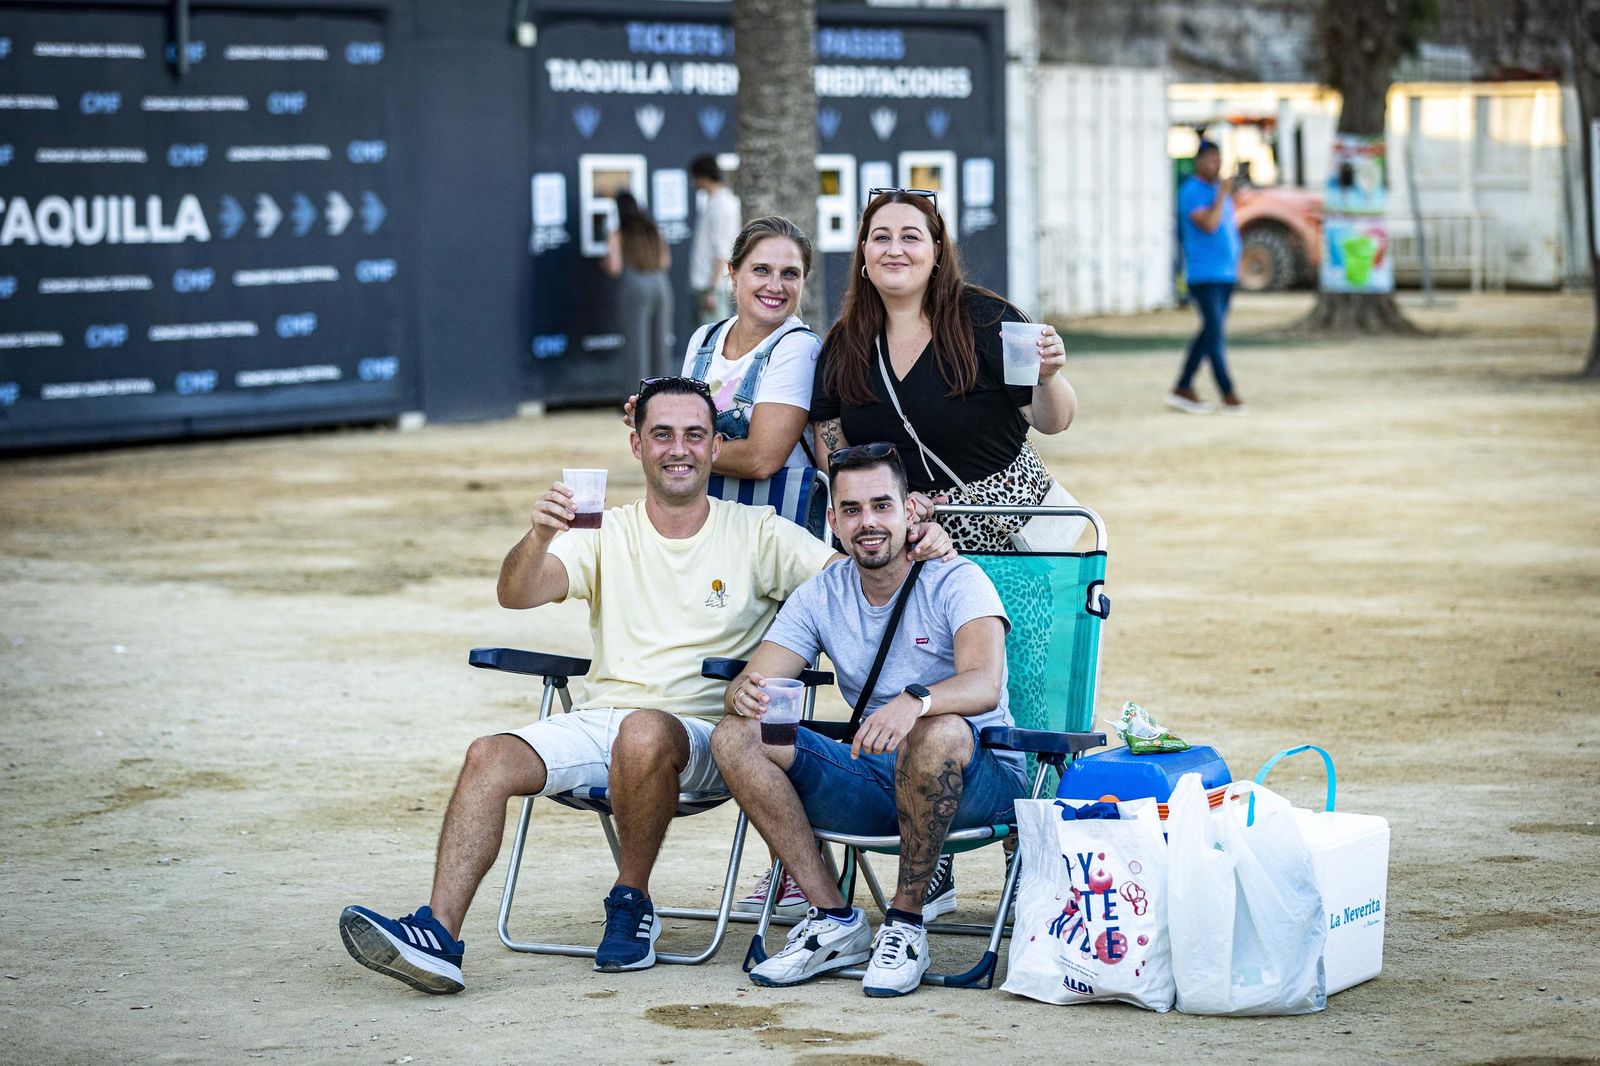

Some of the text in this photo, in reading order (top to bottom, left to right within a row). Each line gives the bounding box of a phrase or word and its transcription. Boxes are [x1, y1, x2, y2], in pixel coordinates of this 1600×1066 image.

[625, 23, 723, 56] TICKETS
[545, 58, 672, 94] TAQUILLA
[1330, 913, 1341, 930] La
[1343, 898, 1380, 924] Neverita
[1063, 975, 1094, 994] ALDI
